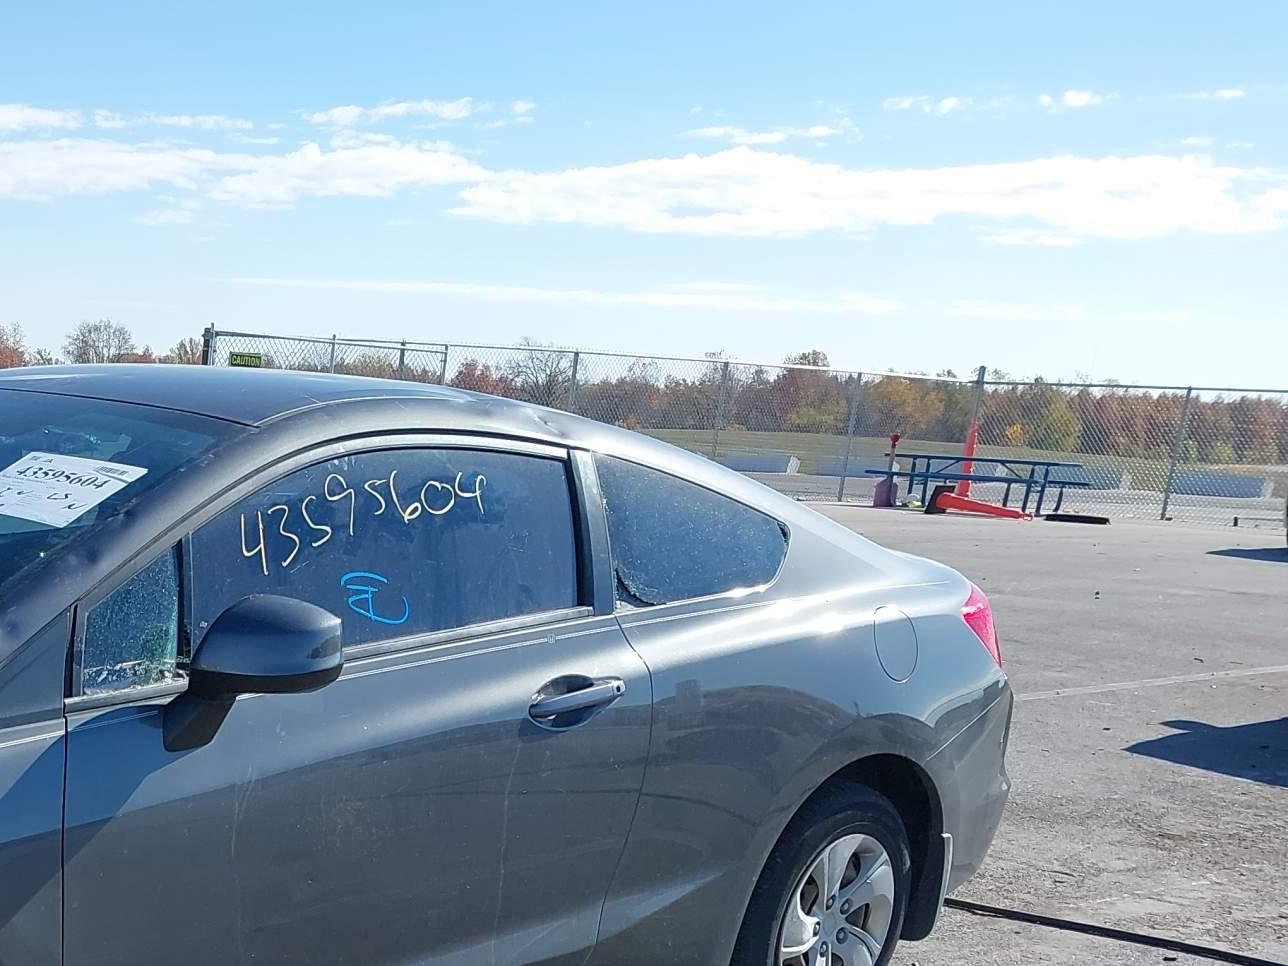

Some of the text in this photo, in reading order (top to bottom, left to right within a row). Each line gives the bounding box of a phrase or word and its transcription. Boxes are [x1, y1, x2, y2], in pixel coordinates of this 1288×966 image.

[232, 355, 261, 366] CAUTION
[16, 466, 111, 489] 43595604
[241, 470, 487, 576] 43595604
